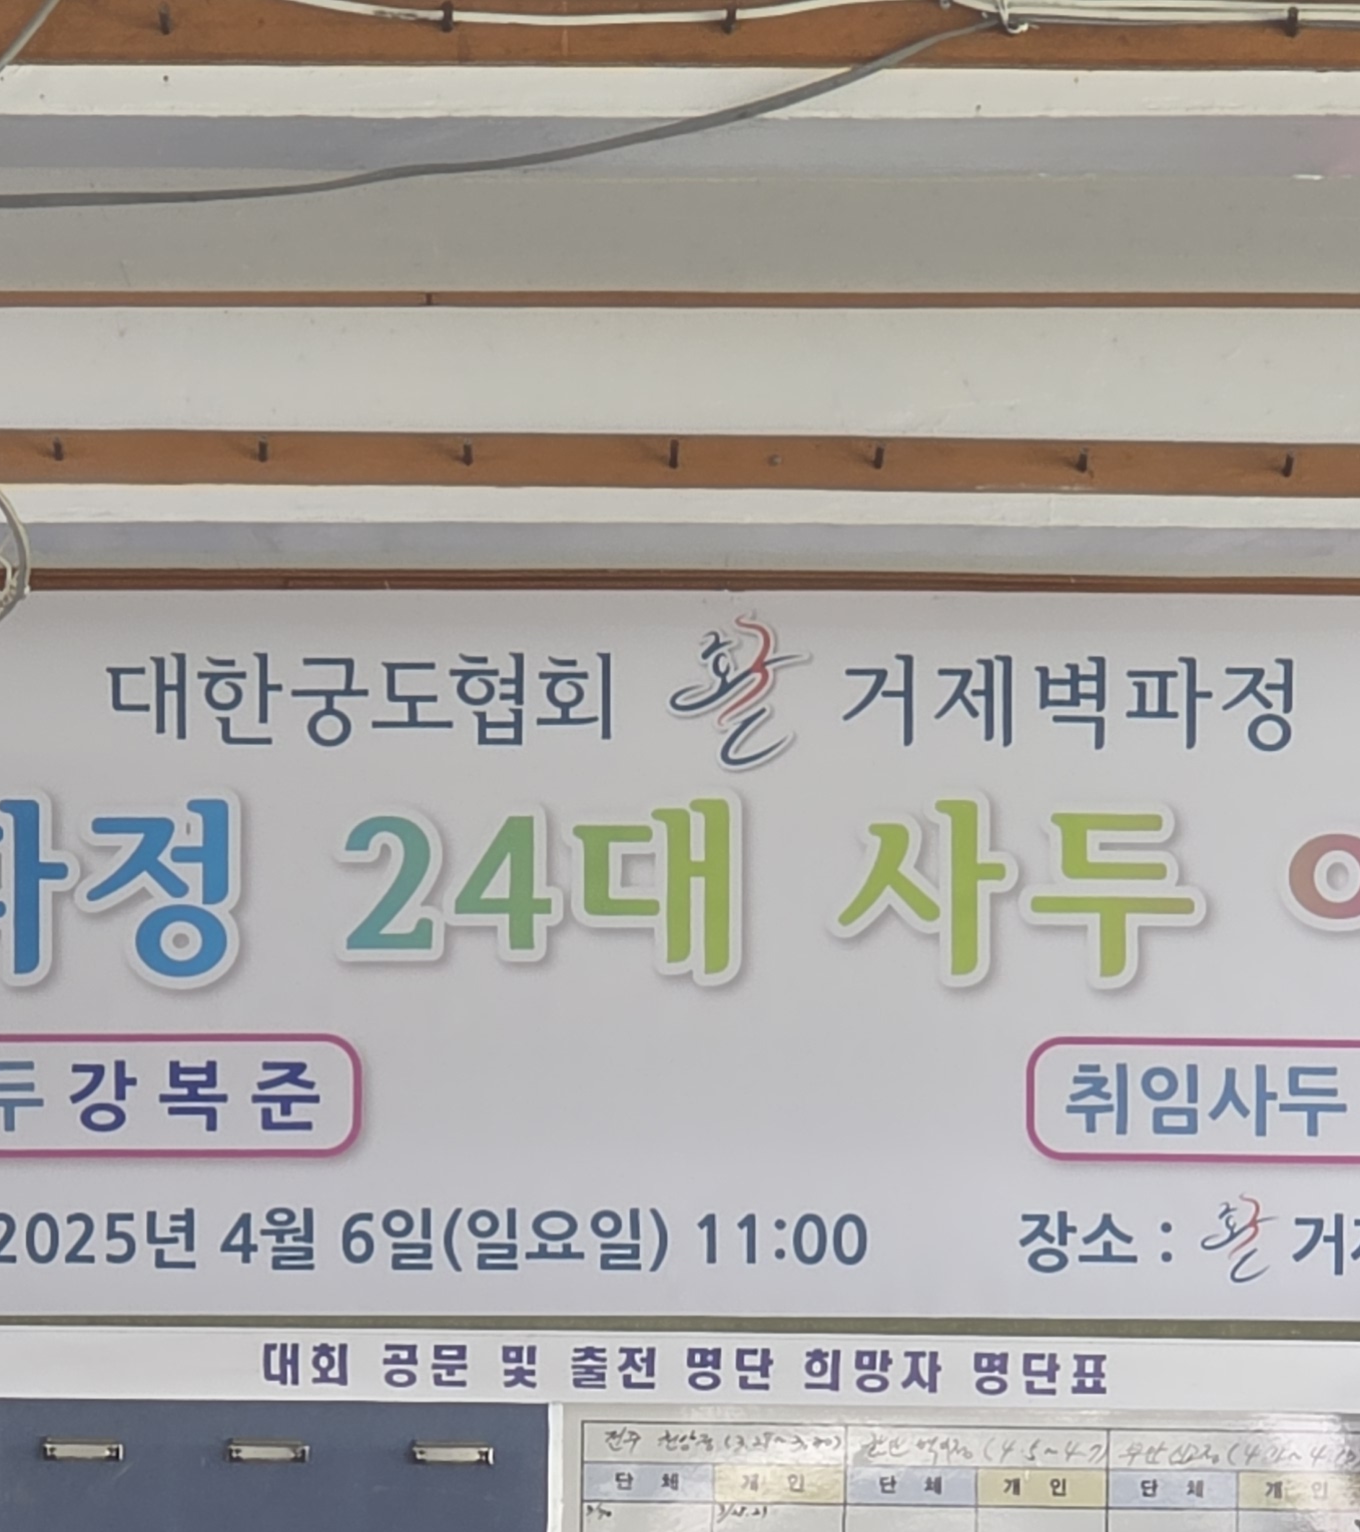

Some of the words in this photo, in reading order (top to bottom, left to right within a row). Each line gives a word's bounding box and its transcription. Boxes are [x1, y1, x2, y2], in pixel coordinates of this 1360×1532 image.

[106, 652, 611, 747] 대한궁도협회
[843, 654, 1293, 751] 거제벽파정
[342, 796, 736, 978] 24대
[837, 798, 1197, 981] 사두
[1066, 1063, 1347, 1137] 취임사두
[220, 1208, 315, 1270] 4월
[342, 1208, 668, 1272] 6일(일요일)
[698, 1214, 867, 1265] 11:00
[1019, 1211, 1137, 1273] 장소
[263, 1343, 348, 1386] 대회
[383, 1344, 467, 1387] 공문
[502, 1345, 536, 1388] 및
[571, 1346, 656, 1389] 출전
[687, 1348, 773, 1390] 명단
[805, 1349, 941, 1393] 희망자
[974, 1352, 1106, 1395] 명단표
